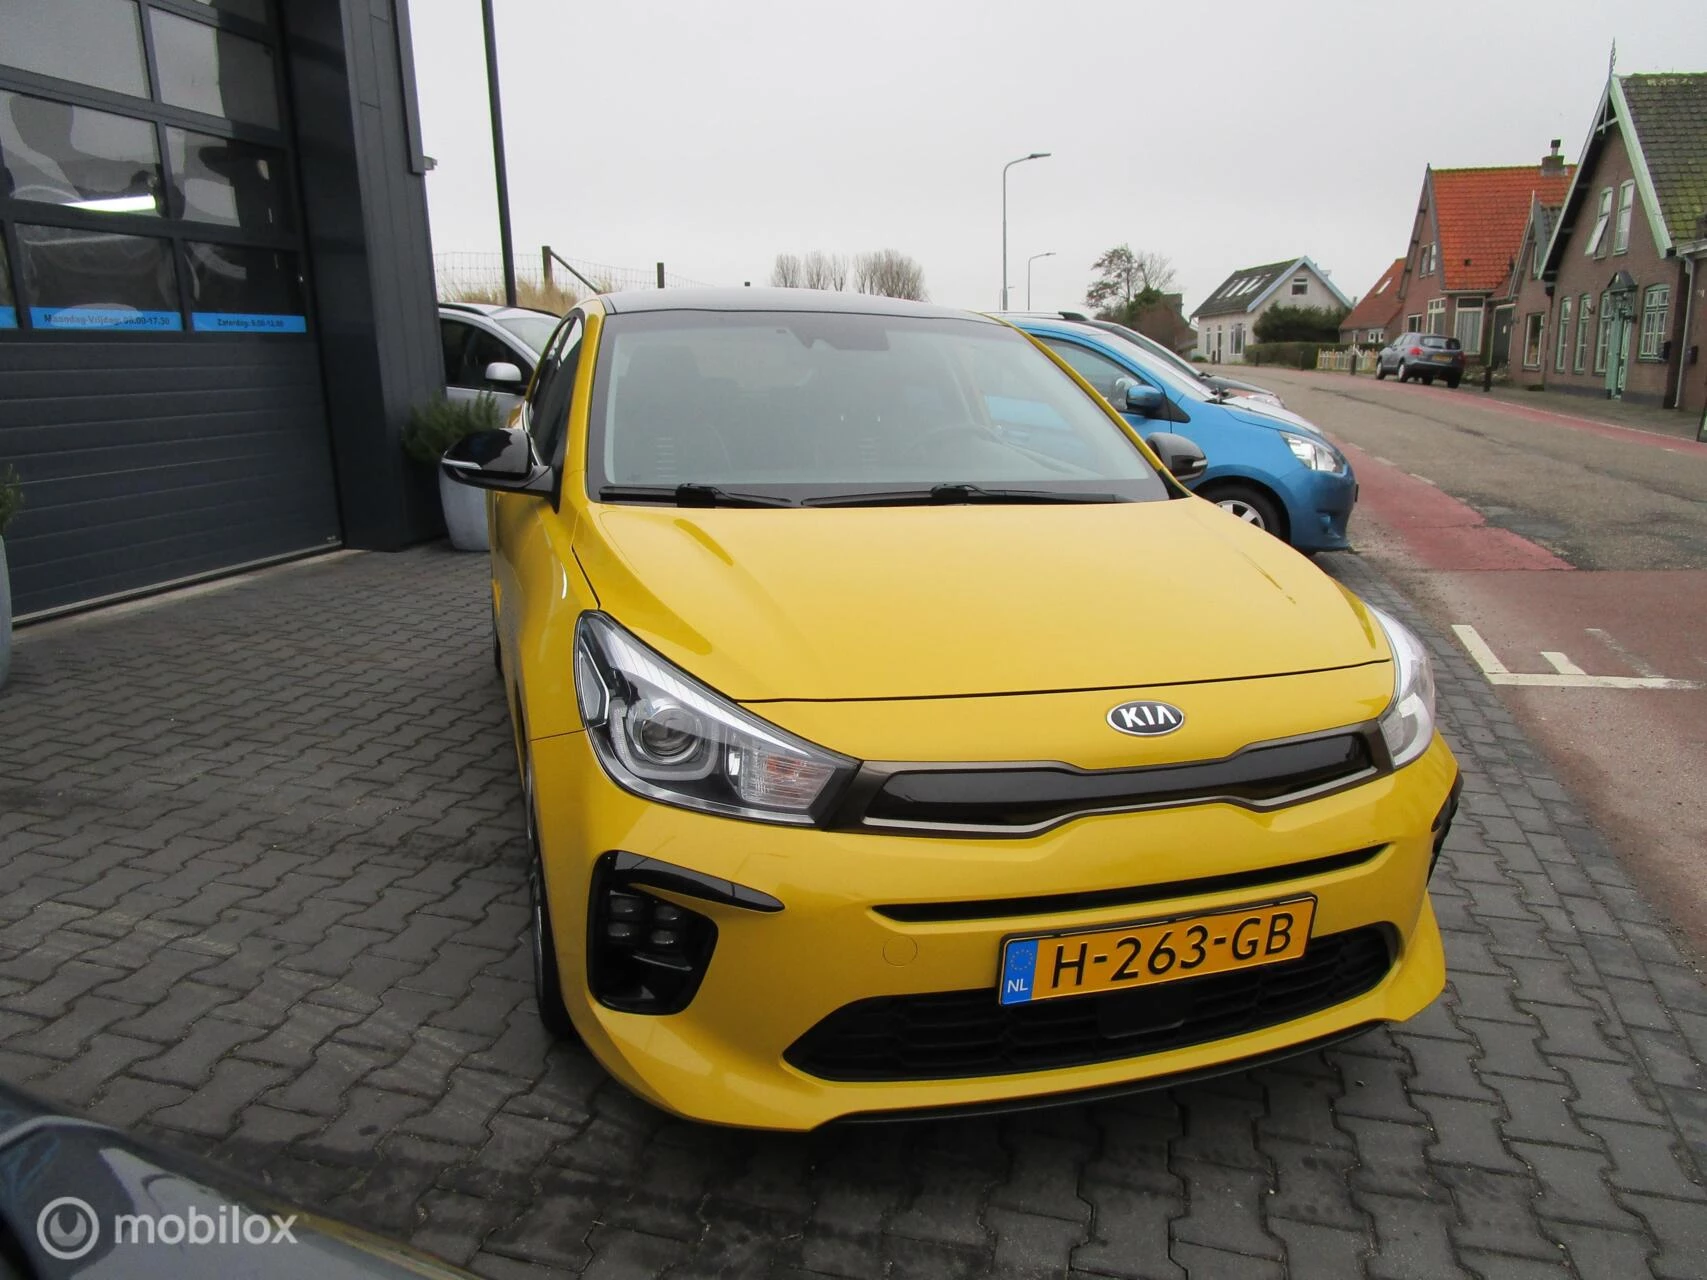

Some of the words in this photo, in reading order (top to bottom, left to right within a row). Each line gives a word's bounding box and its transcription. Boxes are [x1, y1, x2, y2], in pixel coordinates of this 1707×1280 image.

[1118, 705, 1177, 728] KIA
[1051, 912, 1294, 988] H-263-GB
[1007, 978, 1028, 993] NL
